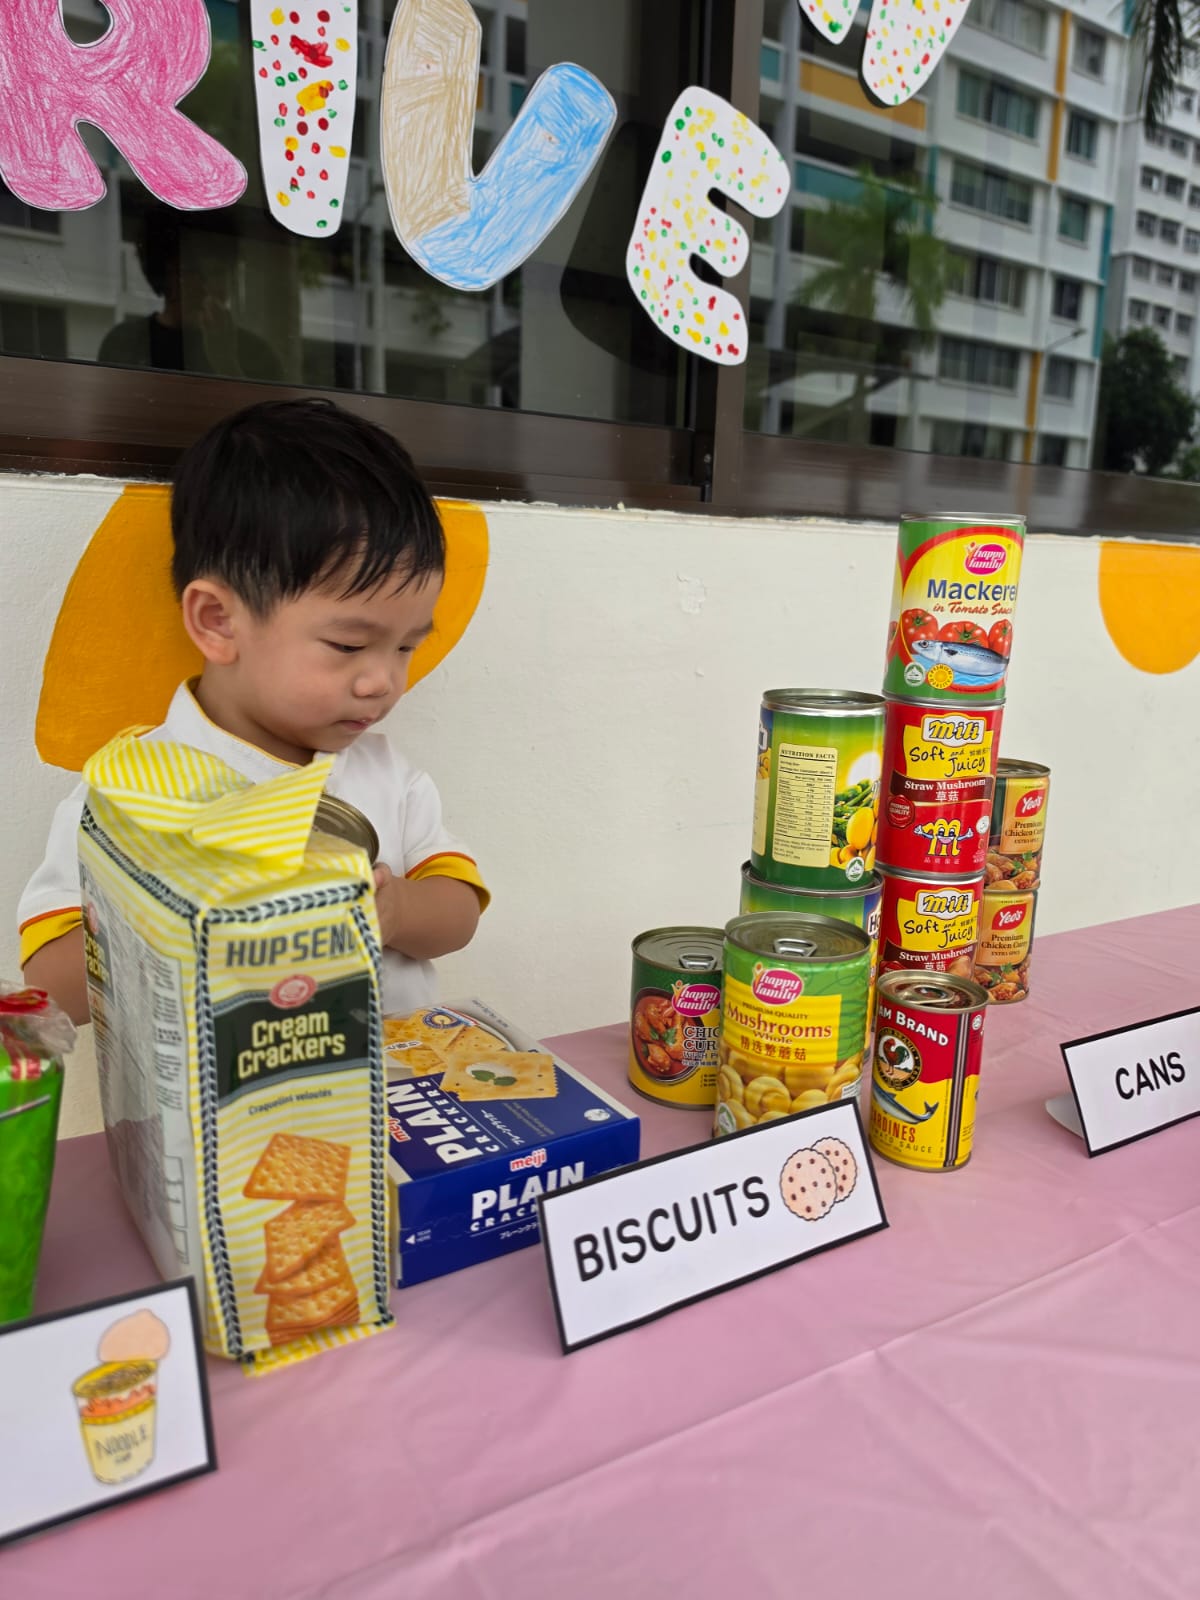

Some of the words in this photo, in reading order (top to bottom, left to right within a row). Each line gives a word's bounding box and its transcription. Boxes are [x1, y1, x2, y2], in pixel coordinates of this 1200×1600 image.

[969, 558, 1002, 569] family
[974, 550, 1005, 560] happy
[933, 603, 944, 612] in
[948, 601, 988, 614] Tomato
[781, 750, 814, 758] NUTRITION
[909, 746, 945, 762] Soft
[944, 757, 986, 777] Juicy
[904, 780, 934, 791] Straw
[936, 778, 986, 791] Mushroom
[936, 791, 959, 801] 草菇
[1022, 796, 1043, 814] Yeo's
[904, 920, 938, 935] Soft
[999, 910, 1023, 927] Yeo's
[938, 925, 973, 948] Juicy
[225, 935, 287, 967] HUP
[900, 951, 929, 962] Straw
[931, 946, 973, 961] Mushroom
[760, 974, 800, 990] happy
[681, 987, 719, 1001] happy
[756, 983, 797, 1001] family
[676, 998, 715, 1011] family
[742, 1002, 773, 1015] PREMIUM
[774, 1011, 808, 1020] QUALITY
[727, 1002, 832, 1038] Mushrooms
[896, 1010, 949, 1047] BRAND
[252, 1011, 330, 1049] Cream
[752, 1030, 793, 1045] Whole
[238, 1033, 346, 1080] Crackers
[1115, 1052, 1186, 1100] CANS
[386, 1083, 484, 1164] PLAIN
[417, 1081, 500, 1153] CRACKERS
[900, 1141, 932, 1153] SAUCE
[510, 1148, 547, 1171] meiji
[471, 1161, 585, 1220] PLAIN
[573, 1176, 770, 1282] BISCUITS
